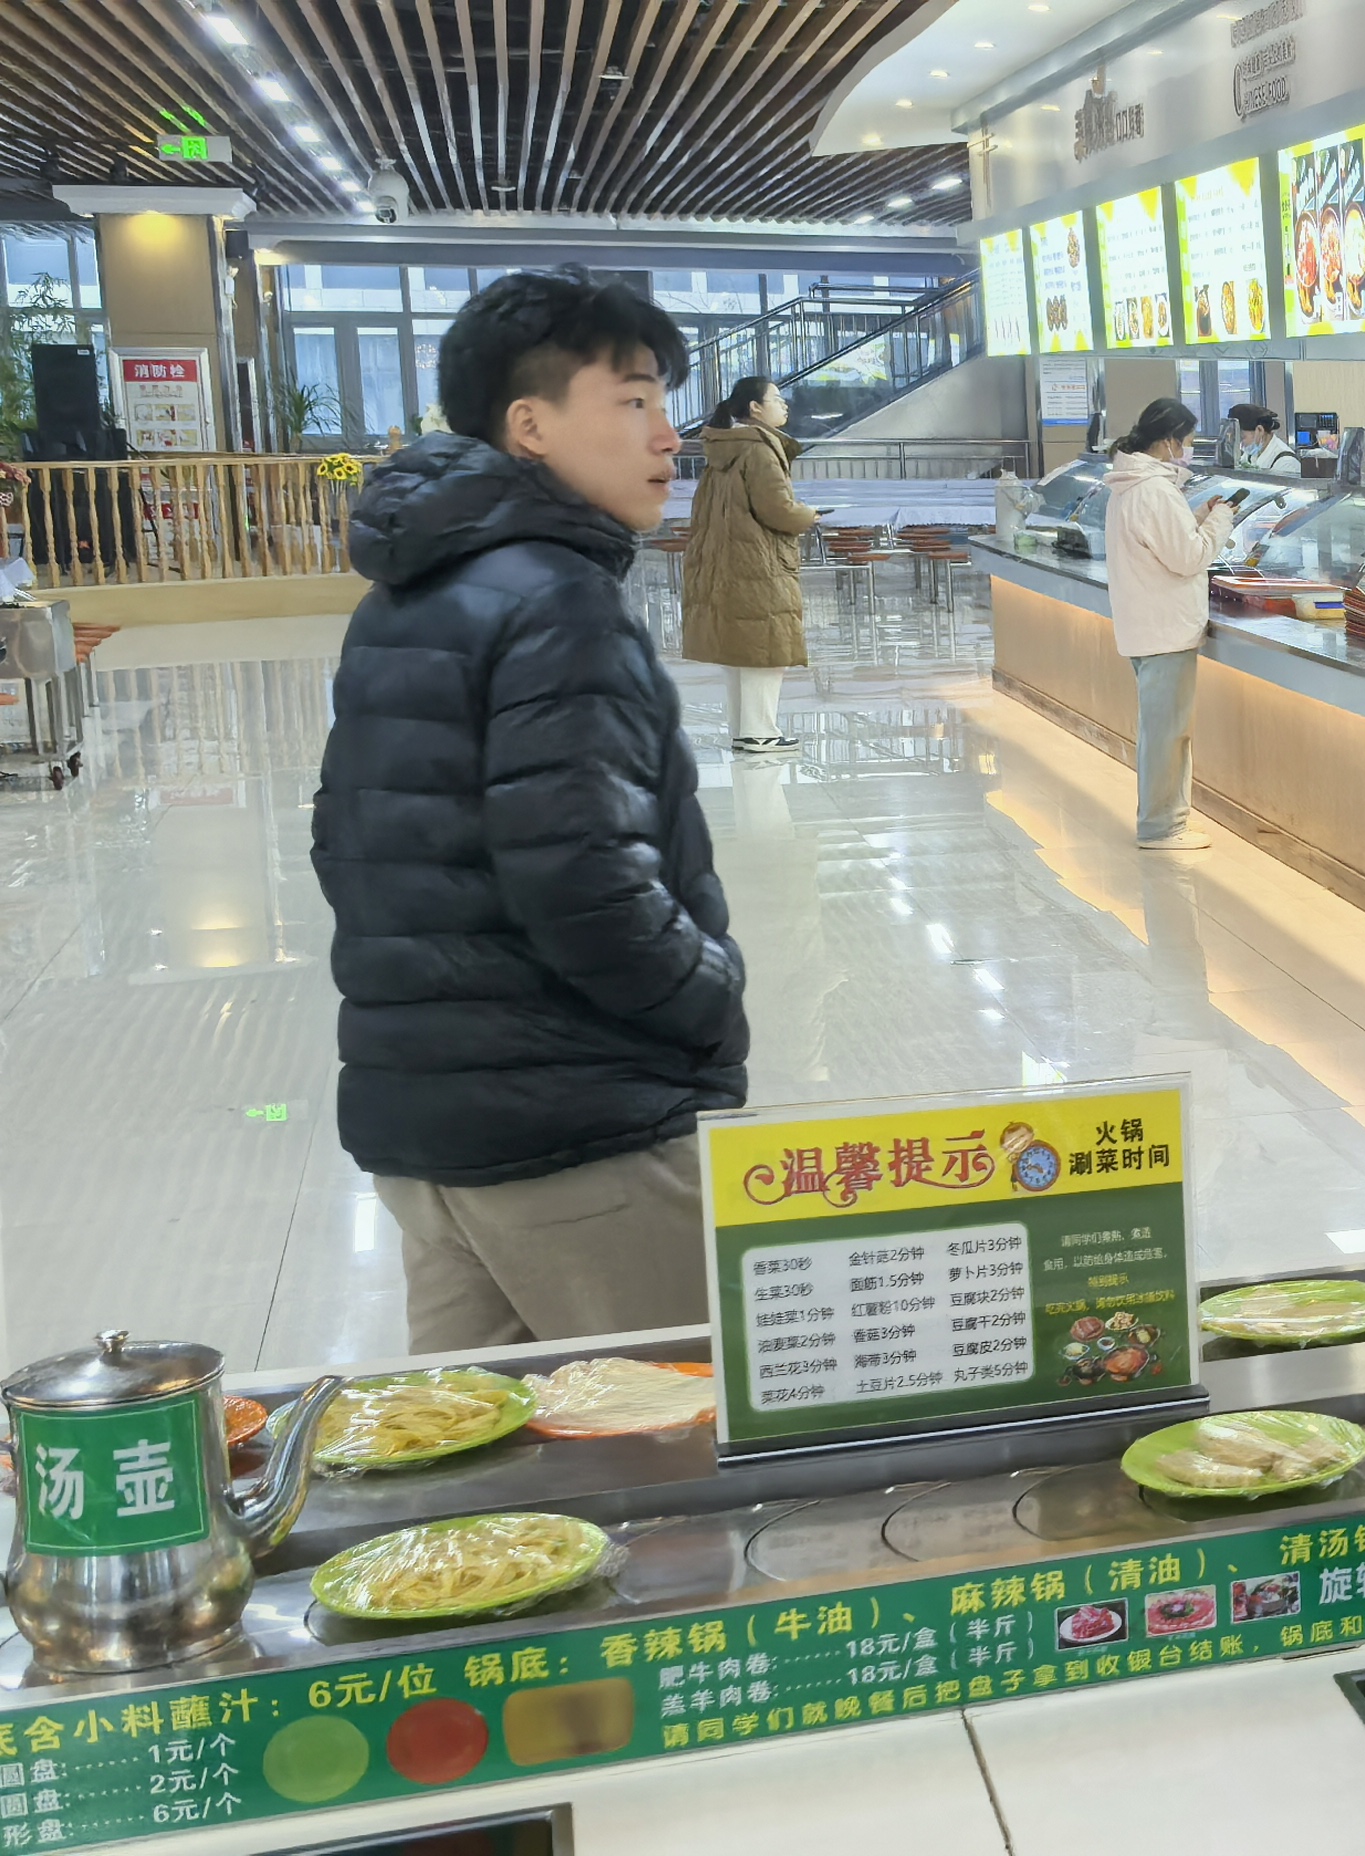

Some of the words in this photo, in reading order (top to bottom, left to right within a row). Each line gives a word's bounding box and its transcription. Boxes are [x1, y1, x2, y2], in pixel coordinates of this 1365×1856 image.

[1095, 1117, 1145, 1147] 火锅
[744, 1129, 996, 1208] 温馨提示
[1068, 1143, 1171, 1176] 涮菜时间
[848, 1245, 925, 1267] 金针菇2分钟
[948, 1235, 1023, 1256] 冬瓜片3分钟
[850, 1271, 925, 1293] 面筋1.5分钟
[949, 1261, 1024, 1283] 萝卜片3分钟
[754, 1281, 815, 1302] 生菜30秒
[950, 1286, 1025, 1308] 豆腐块2分钟
[851, 1295, 936, 1317] 红薯粉10分钟
[951, 1310, 1026, 1333] 豆腐干2分钟
[952, 1335, 1028, 1357] 豆腐皮2分钟
[759, 1356, 838, 1380] 西兰花3分钟
[954, 1360, 1029, 1383] 丸子类5分钟
[856, 1370, 944, 1394] 土豆片2.5分钟
[35, 1438, 176, 1520] 汤壶
[464, 1644, 571, 1688] 锅底：
[600, 1596, 916, 1668] 香辣锅（牛油）、
[949, 1546, 1240, 1614] 麻辣锅（清油）、
[658, 1652, 779, 1690] 肥牛肉卷：
[845, 1610, 1036, 1660] 18元/盒（半斤）
[661, 1680, 780, 1719] 羔羊肉卷：
[847, 1638, 1036, 1687] 18元/盒（半斤）
[148, 1732, 237, 1764] 1元/个
[150, 1762, 240, 1795] 2元/个
[153, 1792, 242, 1824] 6元/个
